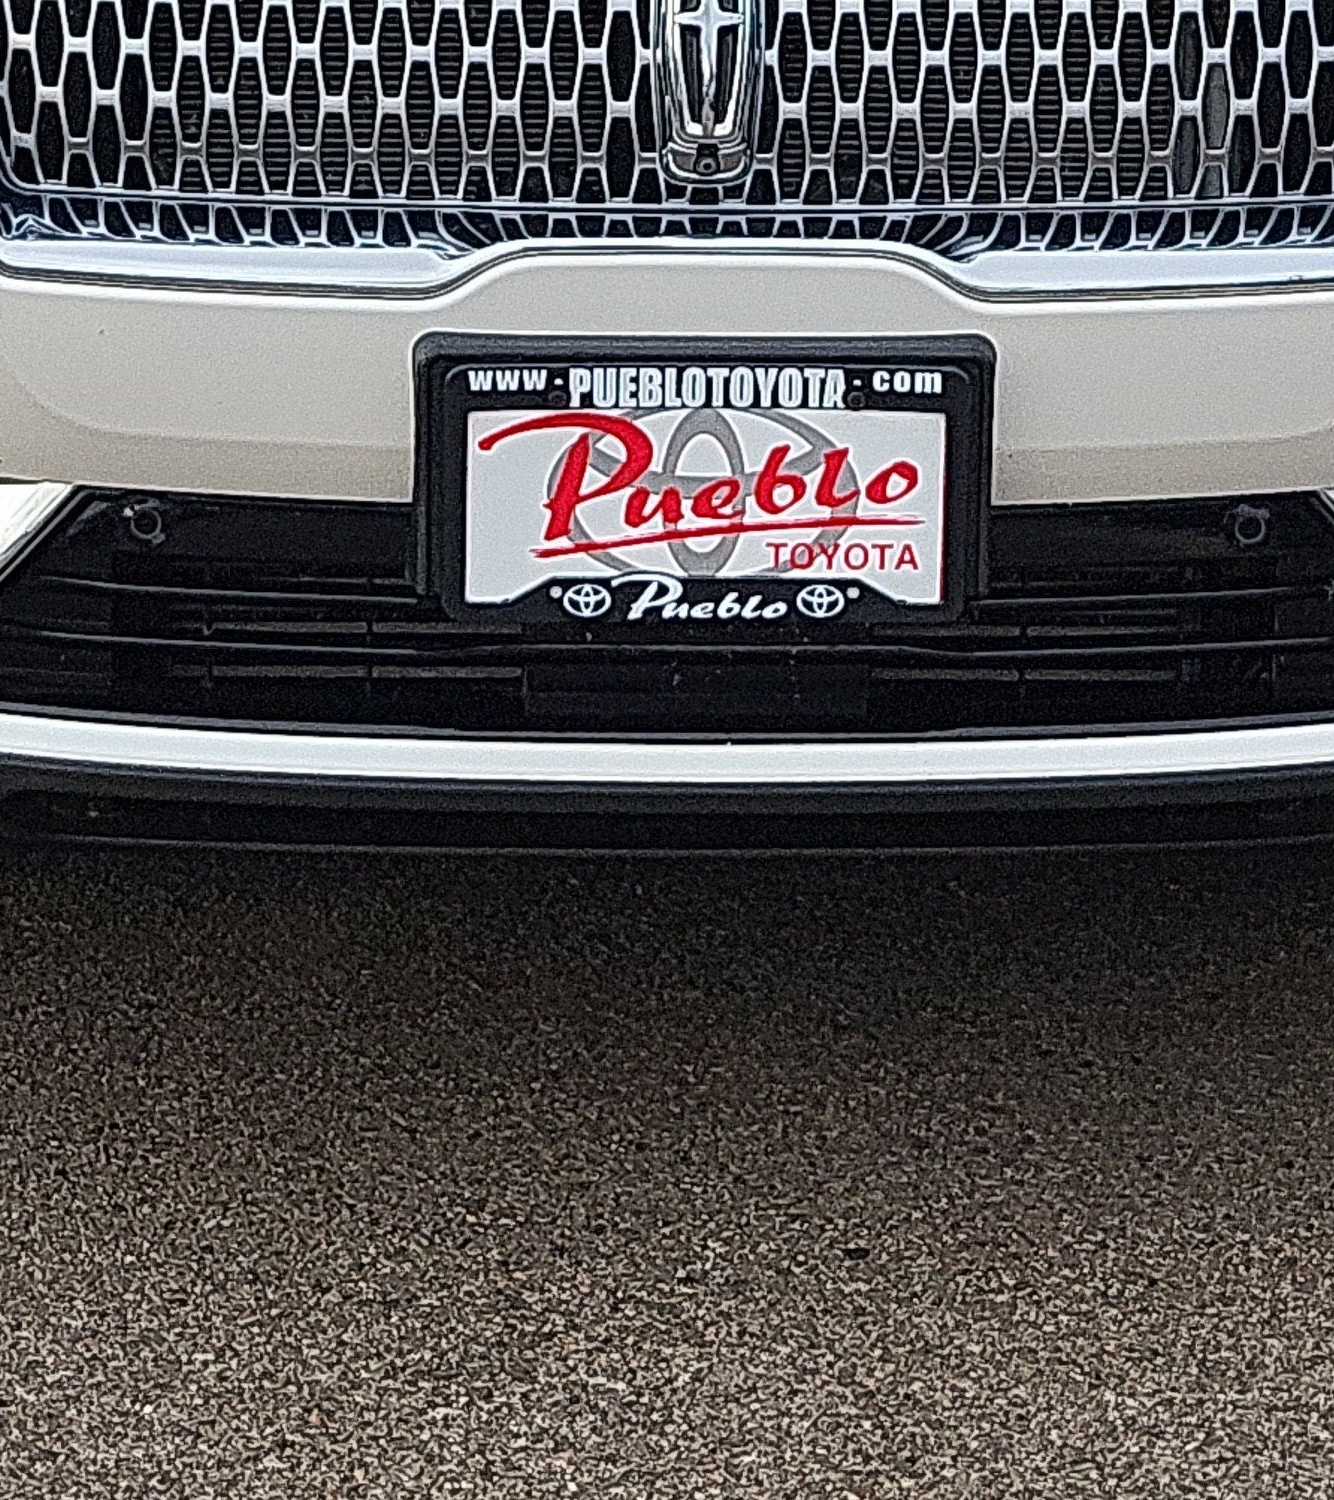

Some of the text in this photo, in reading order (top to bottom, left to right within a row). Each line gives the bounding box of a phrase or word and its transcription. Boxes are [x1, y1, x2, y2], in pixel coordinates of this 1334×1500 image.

[478, 412, 921, 542] Pueblo
[768, 541, 919, 571] TOYOTA
[611, 573, 789, 621] Pueblo
